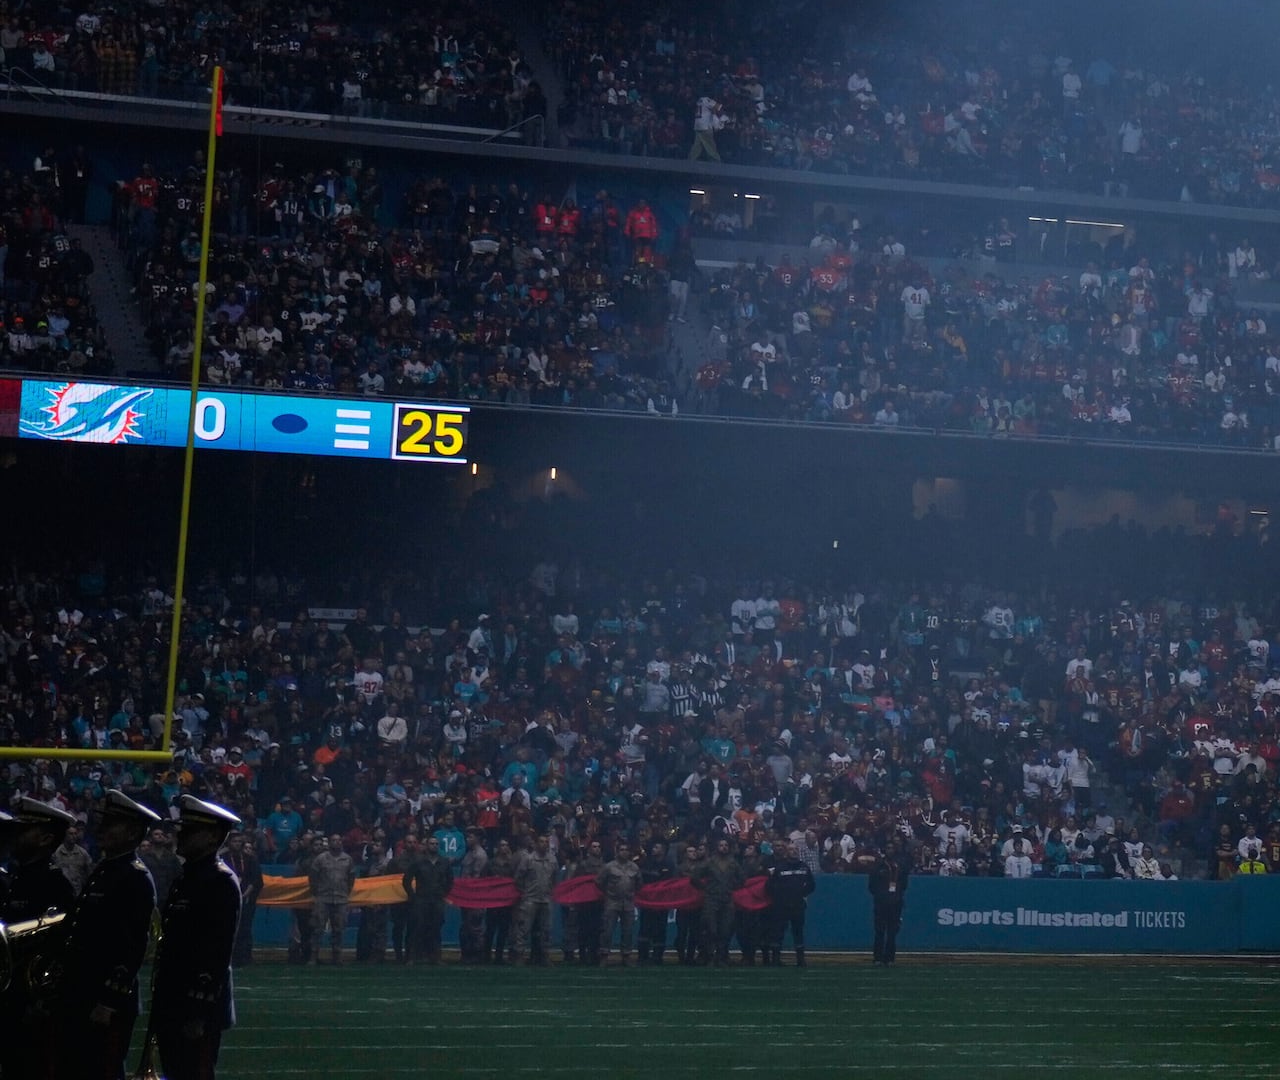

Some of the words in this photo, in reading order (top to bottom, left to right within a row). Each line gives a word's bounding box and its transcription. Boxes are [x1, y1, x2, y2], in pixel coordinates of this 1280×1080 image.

[178, 199, 192, 210] 87
[819, 274, 834, 284] 33
[281, 311, 289, 320] 8
[194, 397, 226, 441] 0
[399, 410, 465, 456] 25
[928, 616, 939, 628] 10
[330, 726, 343, 738] 13
[948, 832, 956, 845] 5
[443, 837, 457, 853] 14
[1017, 864, 1023, 876] 1
[937, 908, 1014, 926] Sports
[1017, 908, 1127, 927] Illustrated
[1134, 911, 1185, 928] TICKETS
